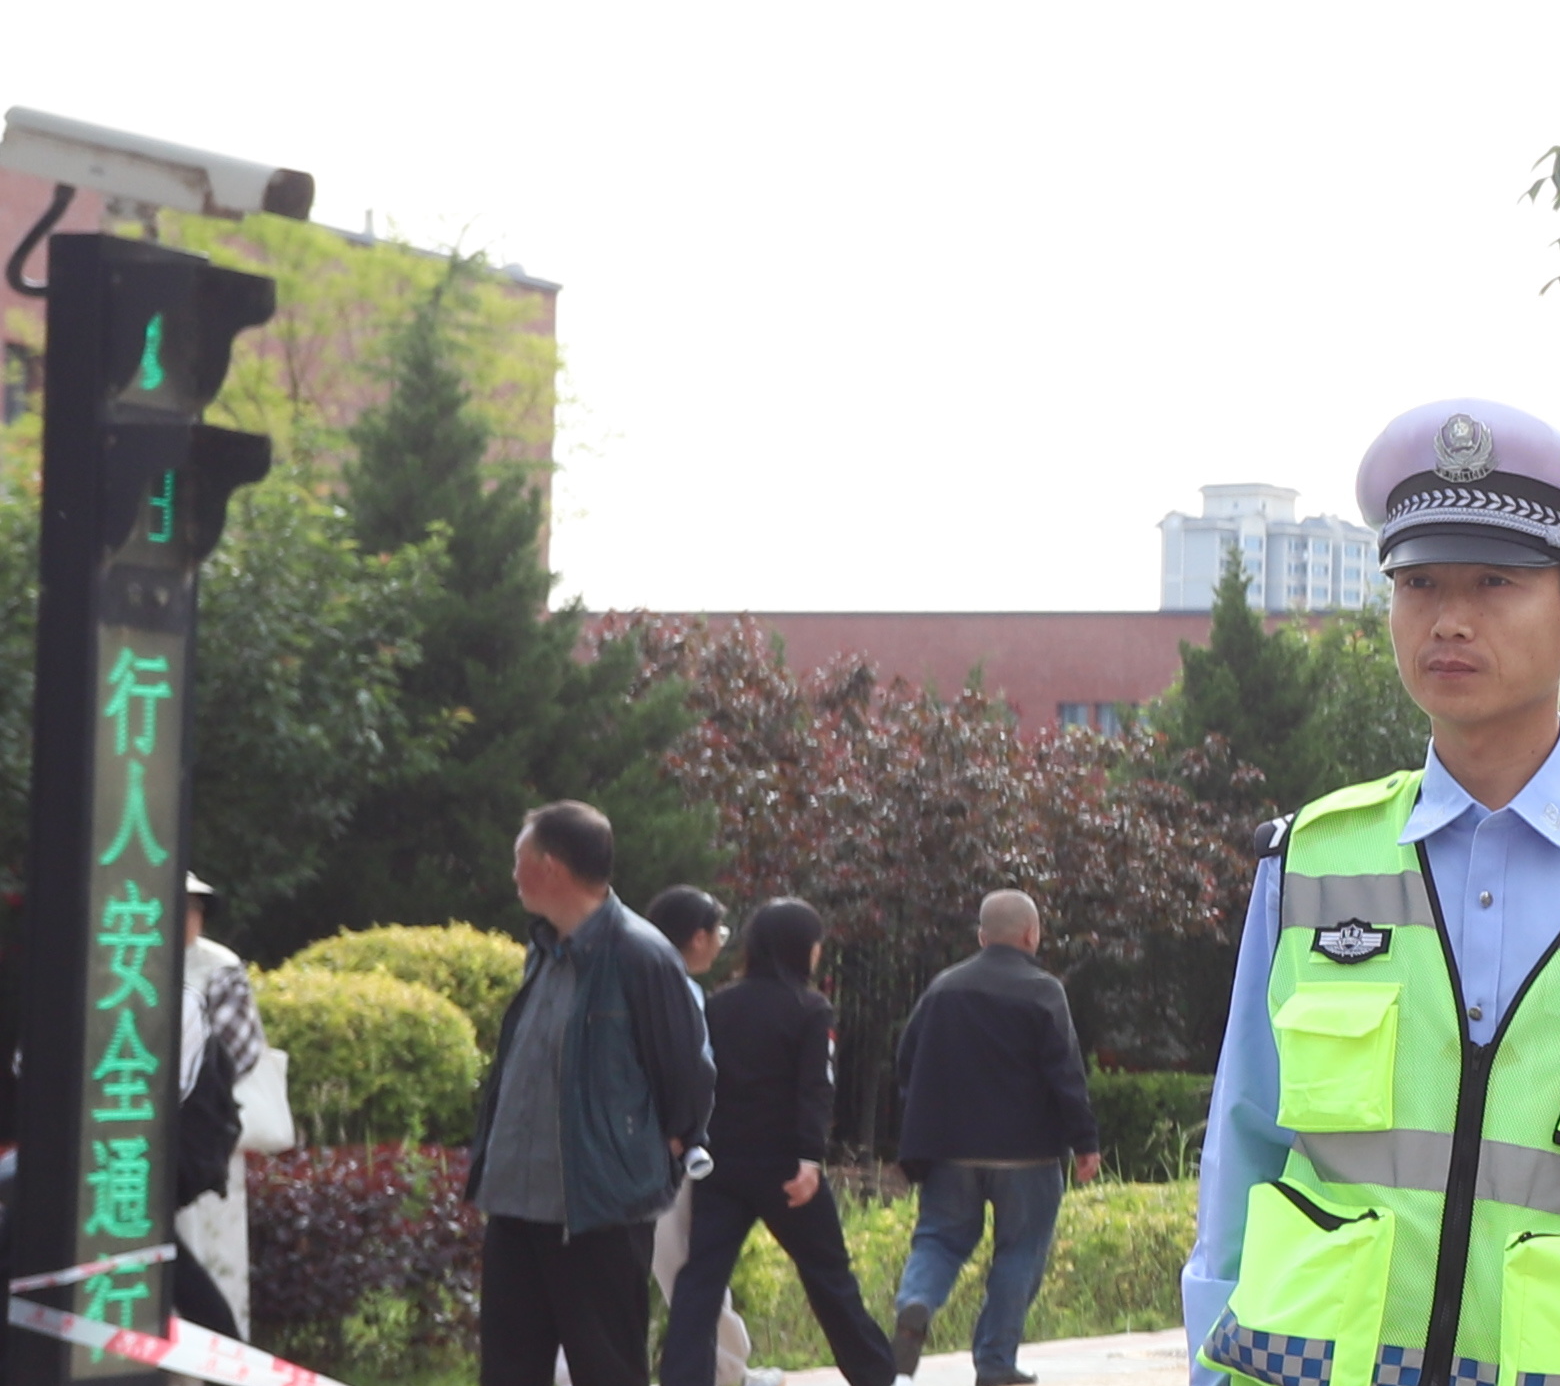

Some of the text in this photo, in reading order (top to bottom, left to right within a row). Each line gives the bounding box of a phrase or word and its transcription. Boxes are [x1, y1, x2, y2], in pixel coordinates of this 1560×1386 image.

[83, 647, 172, 1363] 行人安全通行
